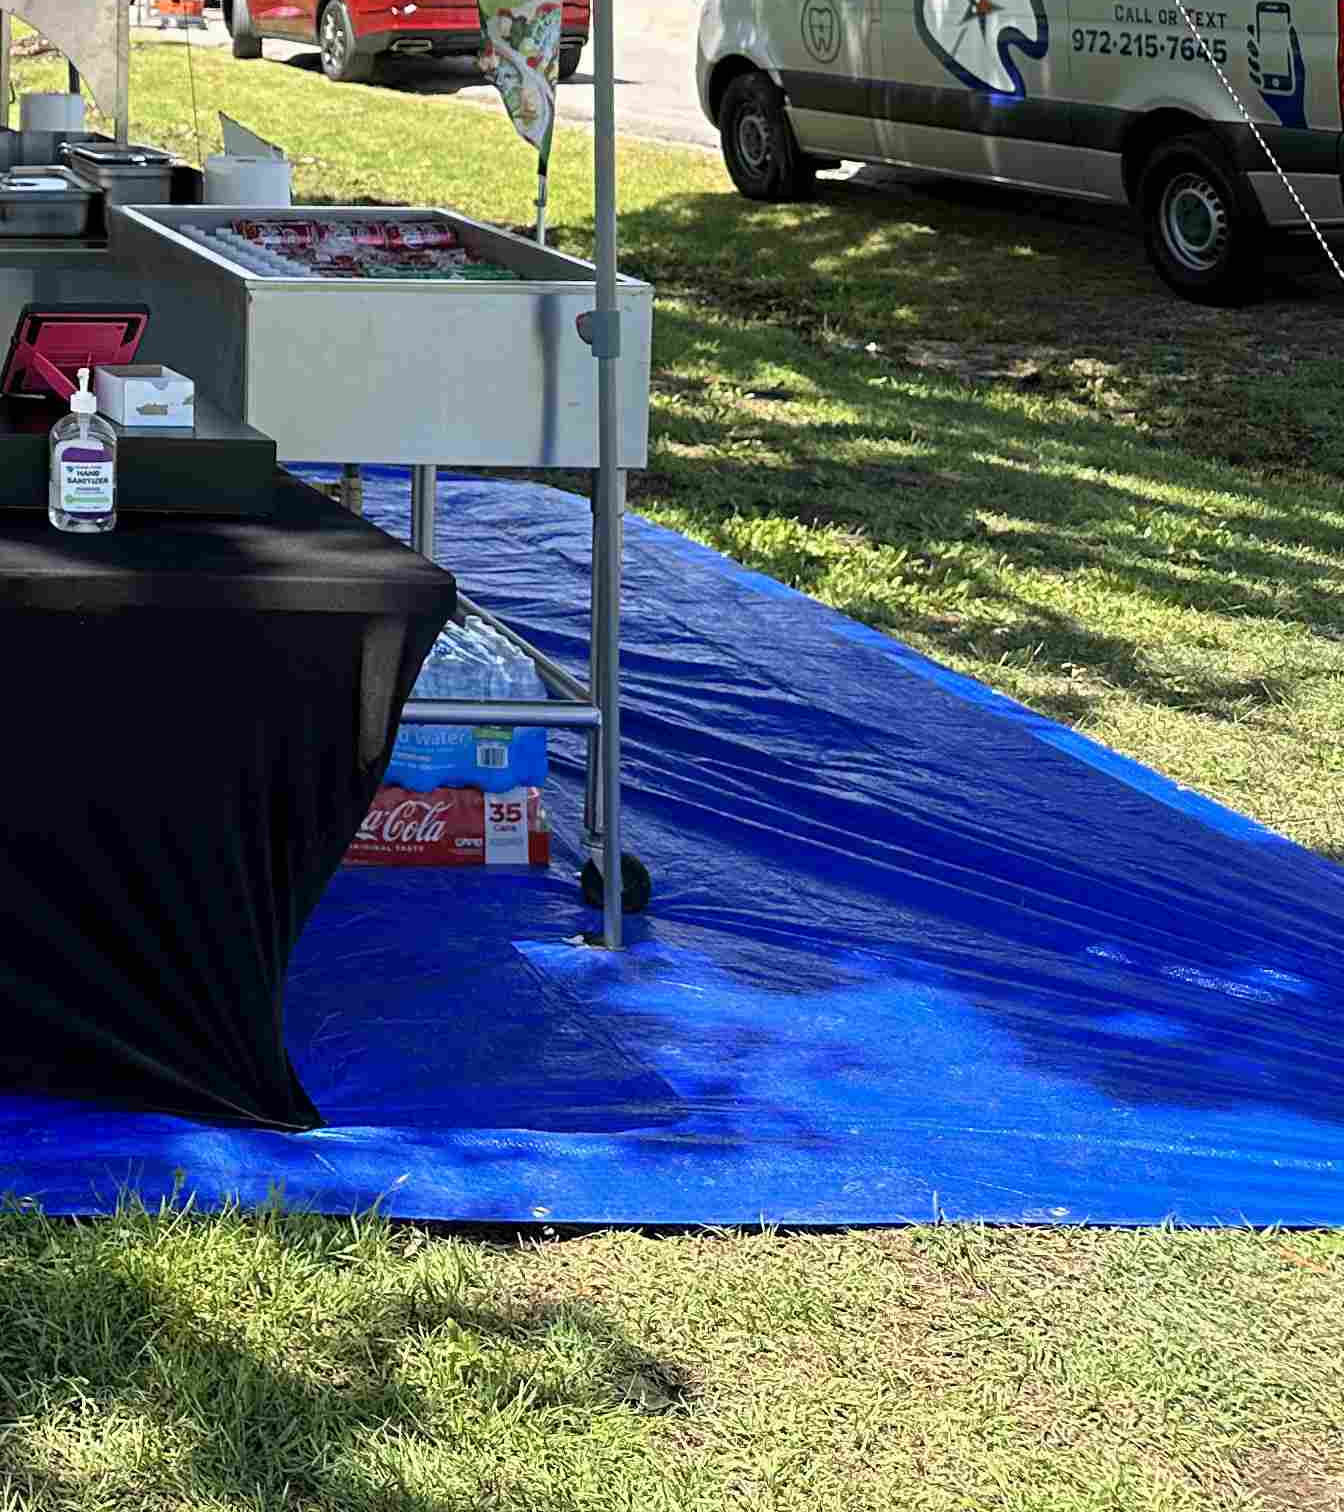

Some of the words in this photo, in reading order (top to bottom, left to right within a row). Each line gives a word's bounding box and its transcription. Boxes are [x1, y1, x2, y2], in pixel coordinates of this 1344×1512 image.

[1114, 4, 1153, 25] CALL
[1158, 9, 1178, 26] OR
[1185, 8, 1228, 30] TEXT
[489, 803, 522, 823] 35
